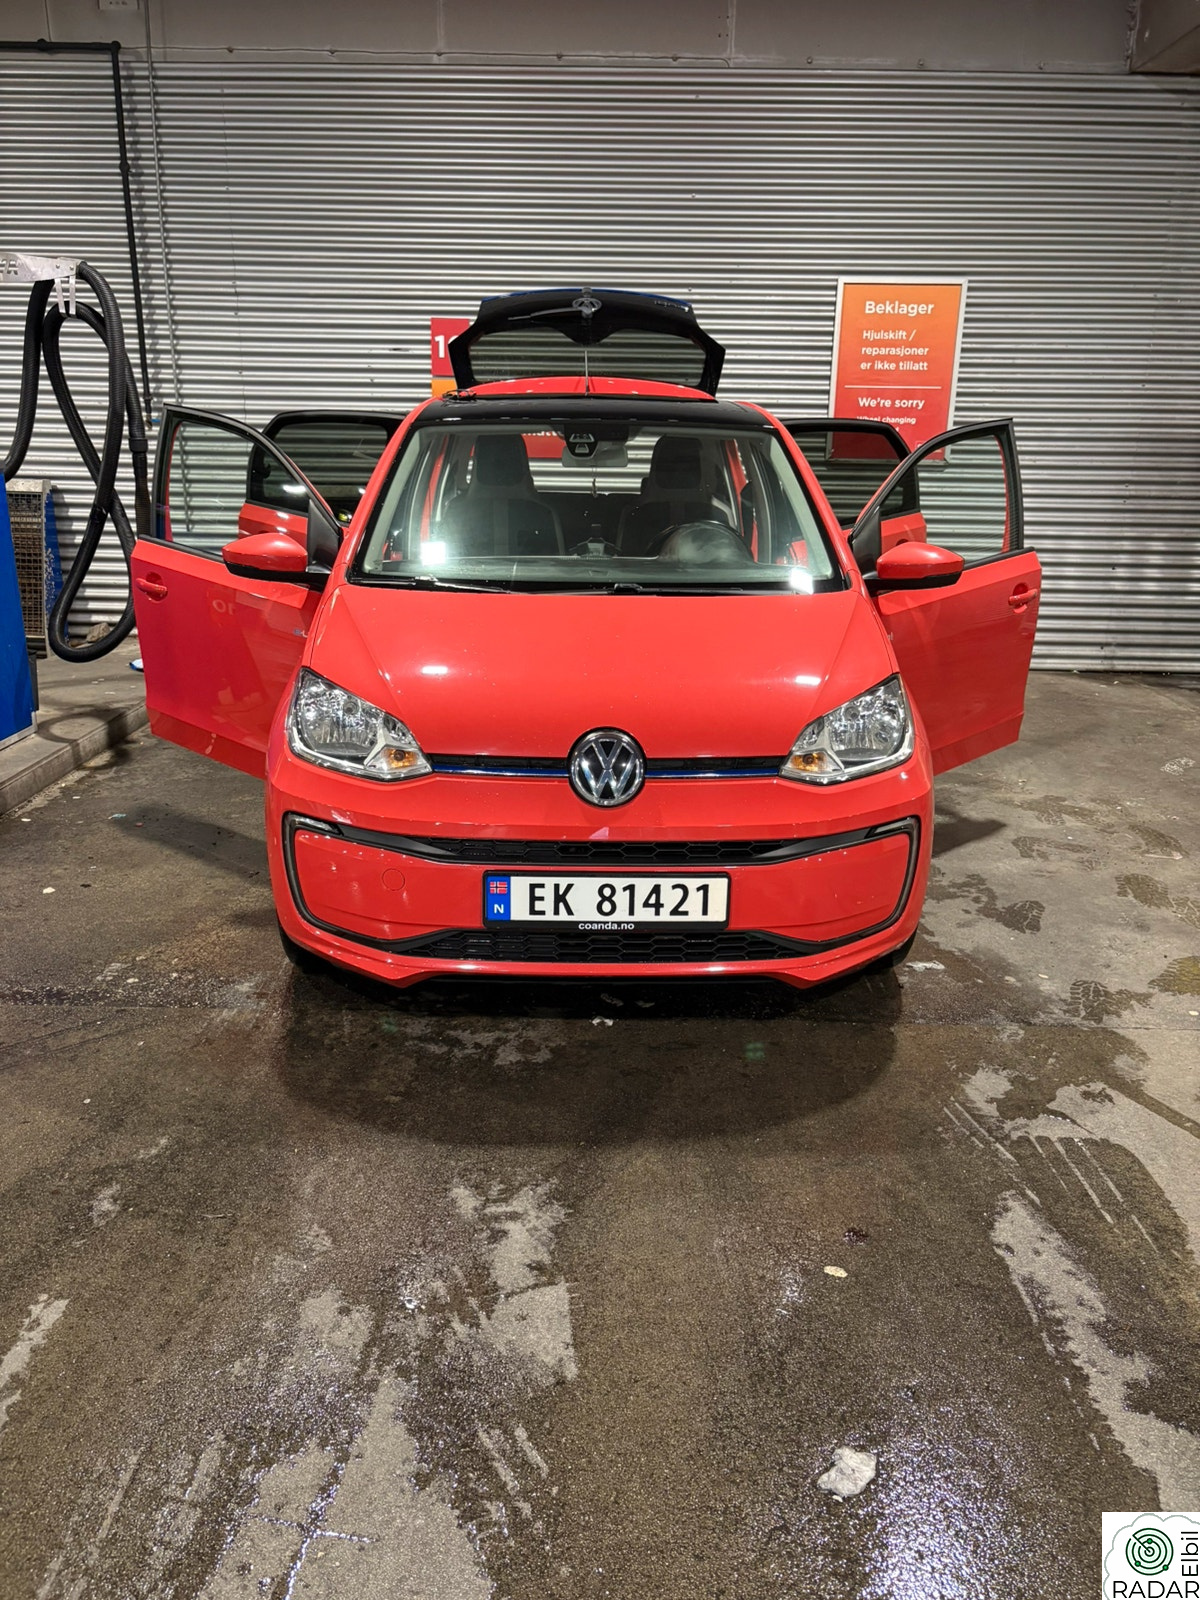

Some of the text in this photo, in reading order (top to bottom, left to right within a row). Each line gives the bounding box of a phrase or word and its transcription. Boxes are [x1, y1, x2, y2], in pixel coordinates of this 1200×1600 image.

[864, 300, 935, 317] Beklager
[862, 329, 907, 341] Hjulskift
[861, 346, 929, 357] reparasjoner
[860, 360, 928, 371] er ikke tillatt
[858, 397, 925, 410] We're sorry
[881, 416, 916, 425] changing
[528, 883, 710, 917] EK 81421
[493, 903, 505, 914] N
[578, 922, 635, 931] coanda.no
